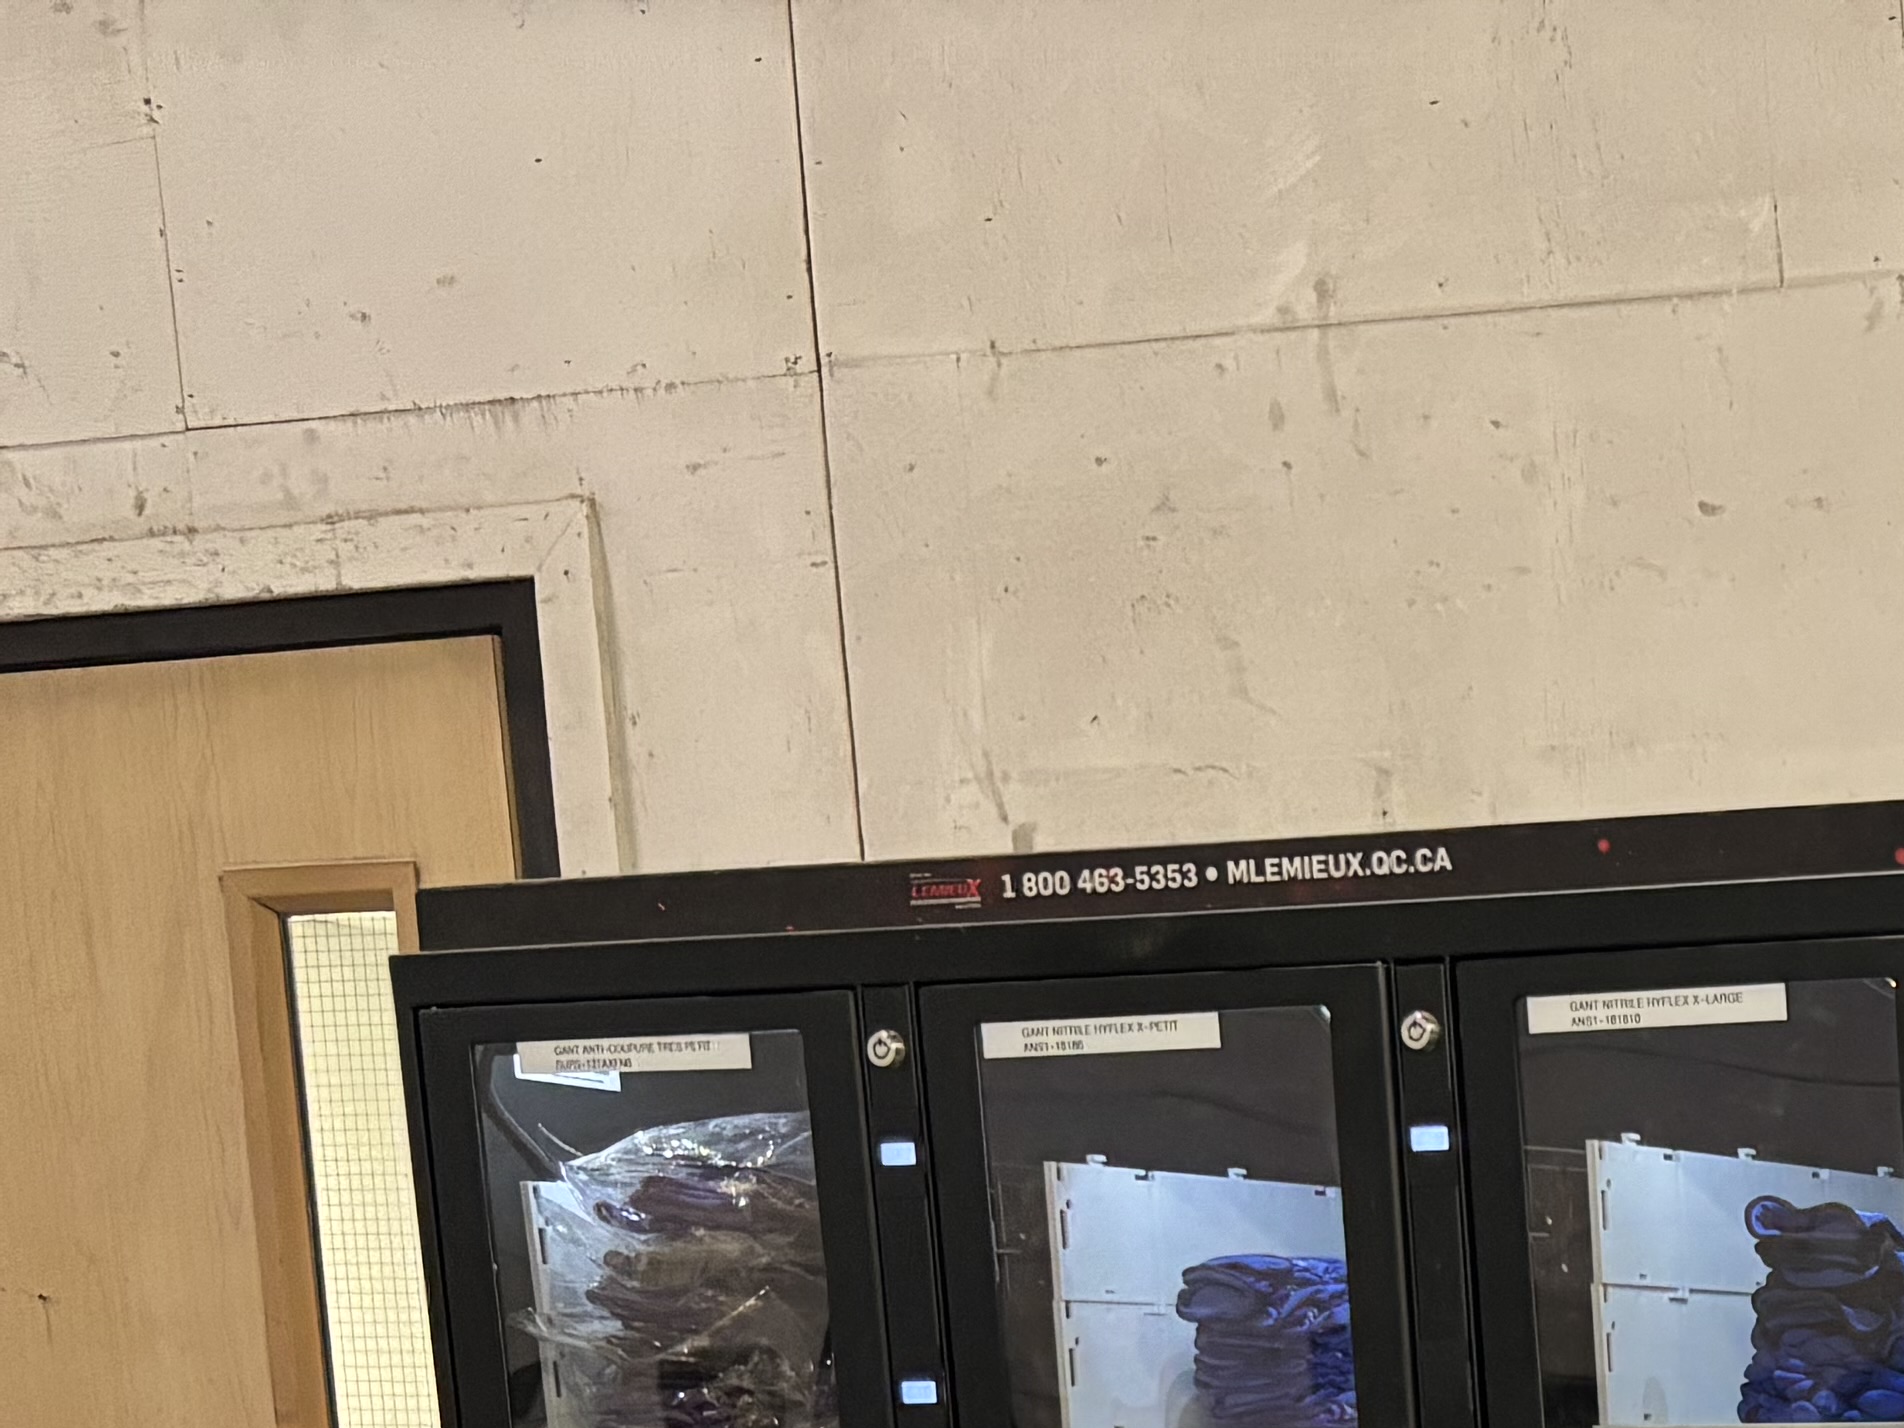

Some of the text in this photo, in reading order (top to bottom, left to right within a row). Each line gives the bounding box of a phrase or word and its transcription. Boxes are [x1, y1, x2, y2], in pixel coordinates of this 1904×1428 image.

[1002, 846, 1453, 899] 1 800 463-5353 MLEMIEUX.QC.CA
[1569, 999, 1598, 1011] GANT
